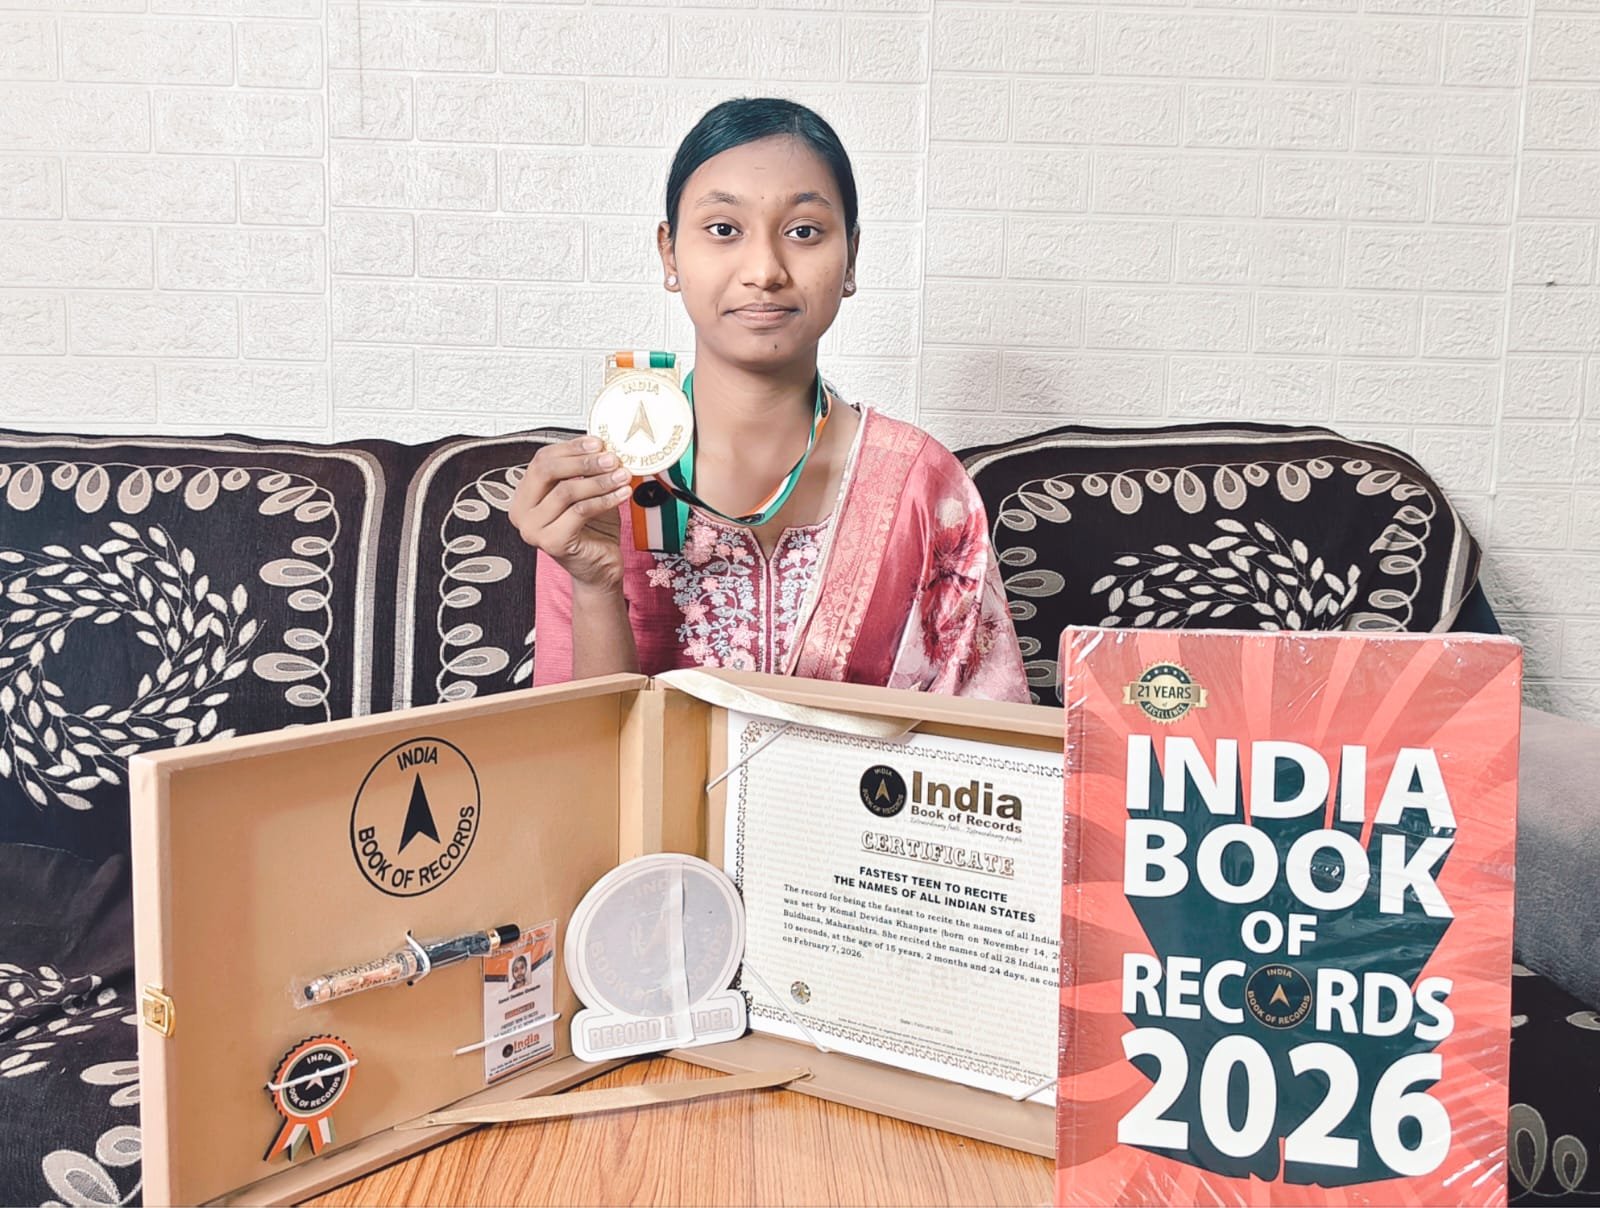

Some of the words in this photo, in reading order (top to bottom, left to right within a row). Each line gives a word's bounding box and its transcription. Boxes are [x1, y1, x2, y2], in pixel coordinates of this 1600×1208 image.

[1137, 685, 1150, 698] 21
[1153, 686, 1192, 700] YEARS
[397, 746, 438, 771] INDIA
[1127, 734, 1456, 829] INDIA
[912, 770, 1022, 821] India
[911, 805, 944, 821] Book
[948, 812, 961, 823] of
[966, 816, 1022, 834] Records
[358, 826, 393, 882] BOOK
[391, 868, 415, 888] OF
[419, 805, 475, 887] RECORDS
[862, 831, 1014, 876] CERTIFICATE
[1124, 818, 1455, 919] BOOK
[834, 875, 855, 887] THE
[859, 880, 898, 895] NAMES
[901, 888, 917, 899] OF
[920, 892, 940, 904] ALL
[945, 897, 986, 913] INDIAN
[990, 906, 1036, 923] STATES
[860, 866, 908, 883] FASTEST
[912, 876, 941, 890] TEEN
[945, 883, 960, 894] TO
[964, 886, 1008, 903] RECITE
[784, 884, 799, 893] The
[801, 888, 827, 899] record
[829, 893, 841, 902] for
[843, 896, 866, 908] being
[868, 901, 881, 910] the
[885, 904, 913, 916] fastest
[916, 911, 925, 919] to
[927, 914, 953, 925] recite
[956, 919, 970, 928] the
[973, 924, 1002, 935] names
[1005, 929, 1015, 937] of
[1017, 930, 1028, 940] all
[784, 898, 798, 906] was
[801, 901, 813, 909] set
[817, 903, 827, 912] by
[830, 905, 856, 918] Komal
[860, 911, 893, 925] Devidas
[896, 919, 938, 934] Khanpate
[941, 929, 964, 940] (born
[983, 938, 1029, 954] November
[1033, 948, 1048, 959] 14,
[1240, 910, 1318, 957] OF
[782, 935, 792, 943] on
[794, 936, 830, 952] February
[831, 945, 840, 955] 7,
[841, 947, 864, 959] 2026.
[784, 922, 793, 930] 10
[795, 926, 830, 939] seconds,
[832, 932, 840, 940] at
[842, 935, 856, 943] the
[858, 940, 872, 948] age
[875, 941, 883, 949] of
[886, 944, 896, 952] 15
[898, 947, 923, 960] years,
[934, 955, 968, 968] months
[970, 963, 987, 972] and
[989, 966, 1001, 975] 24
[1003, 969, 1027, 981] days,
[1030, 976, 1040, 984] as
[825, 918, 879, 936] Maharashtra.
[882, 930, 897, 940] She
[900, 934, 930, 947] recited
[932, 941, 947, 950] the
[949, 945, 978, 957] names
[980, 952, 989, 960] of
[991, 953, 1002, 962] all
[1018, 958, 1048, 972] Indian
[1266, 968, 1293, 978] INDIA
[1248, 990, 1265, 1017] BOOK
[1265, 1014, 1277, 1023] OF
[1278, 995, 1310, 1025] RECORDS
[588, 1019, 660, 1050] RECORD
[307, 1053, 333, 1065] INDIA
[288, 1085, 301, 1105] OOK
[310, 1076, 340, 1108] RECORDS
[1117, 1026, 1451, 1177] 2026
